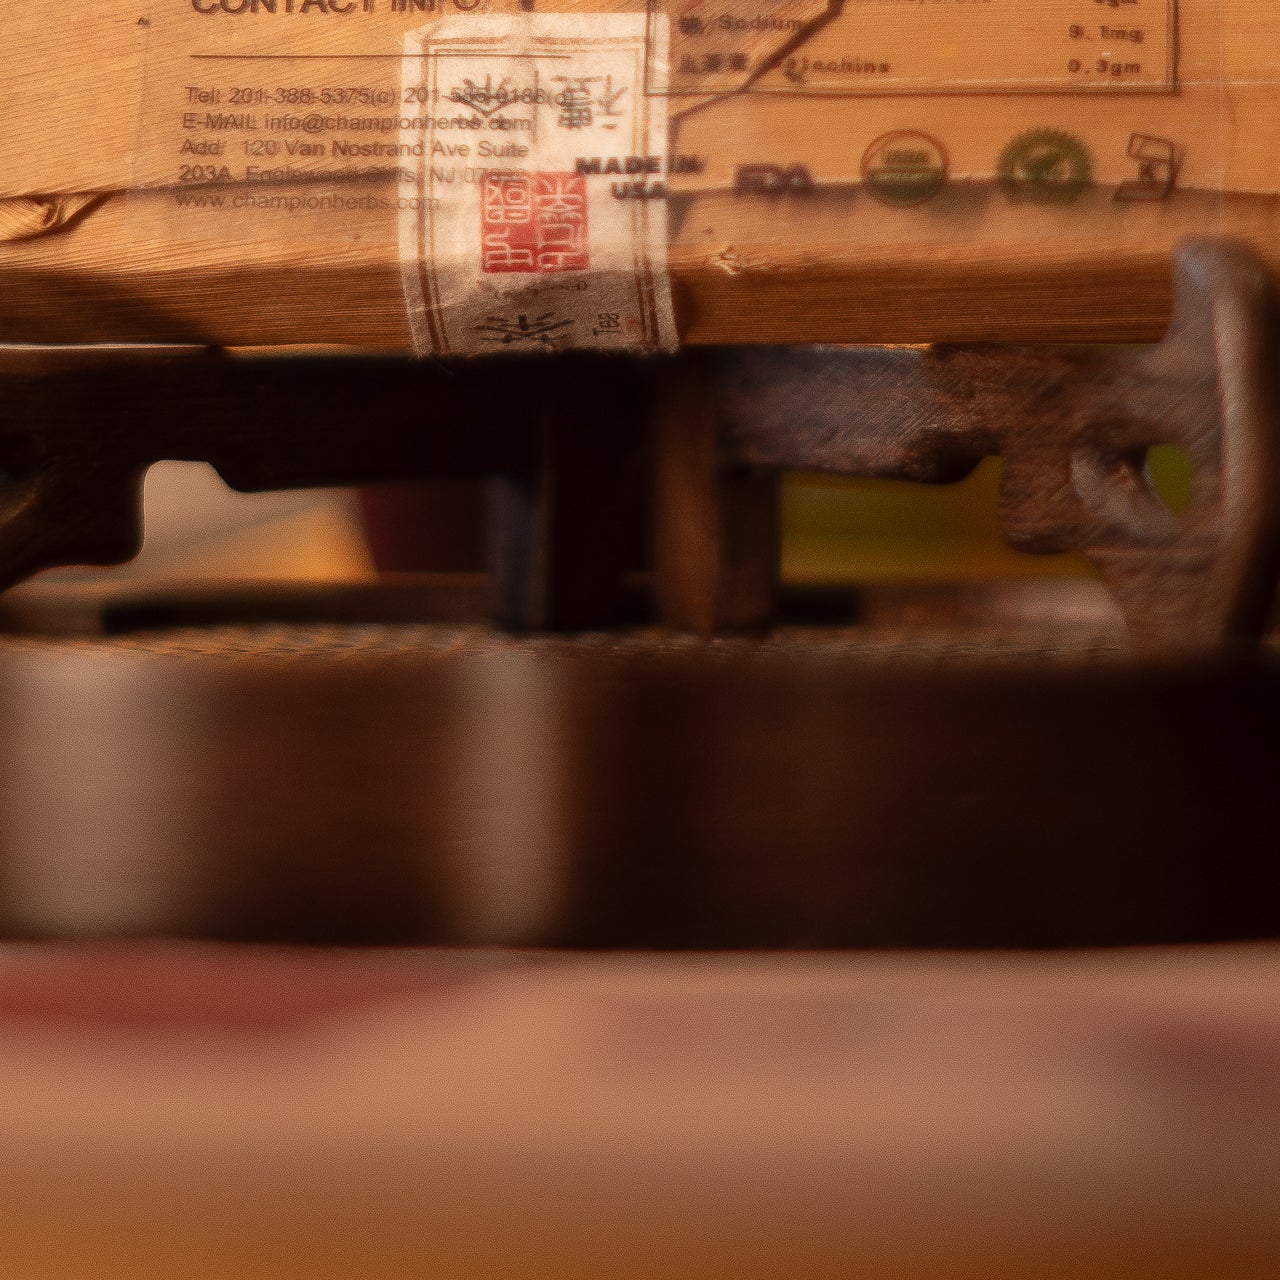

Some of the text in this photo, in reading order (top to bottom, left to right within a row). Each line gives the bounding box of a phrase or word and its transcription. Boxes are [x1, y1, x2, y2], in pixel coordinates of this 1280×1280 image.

[242, 139, 278, 157] 120
[283, 139, 325, 157] Van
[331, 138, 423, 158] Nostrand
[432, 140, 470, 157] Ave
[477, 139, 529, 158] Suite
[575, 156, 662, 175] MADE
[611, 181, 669, 200] USA
